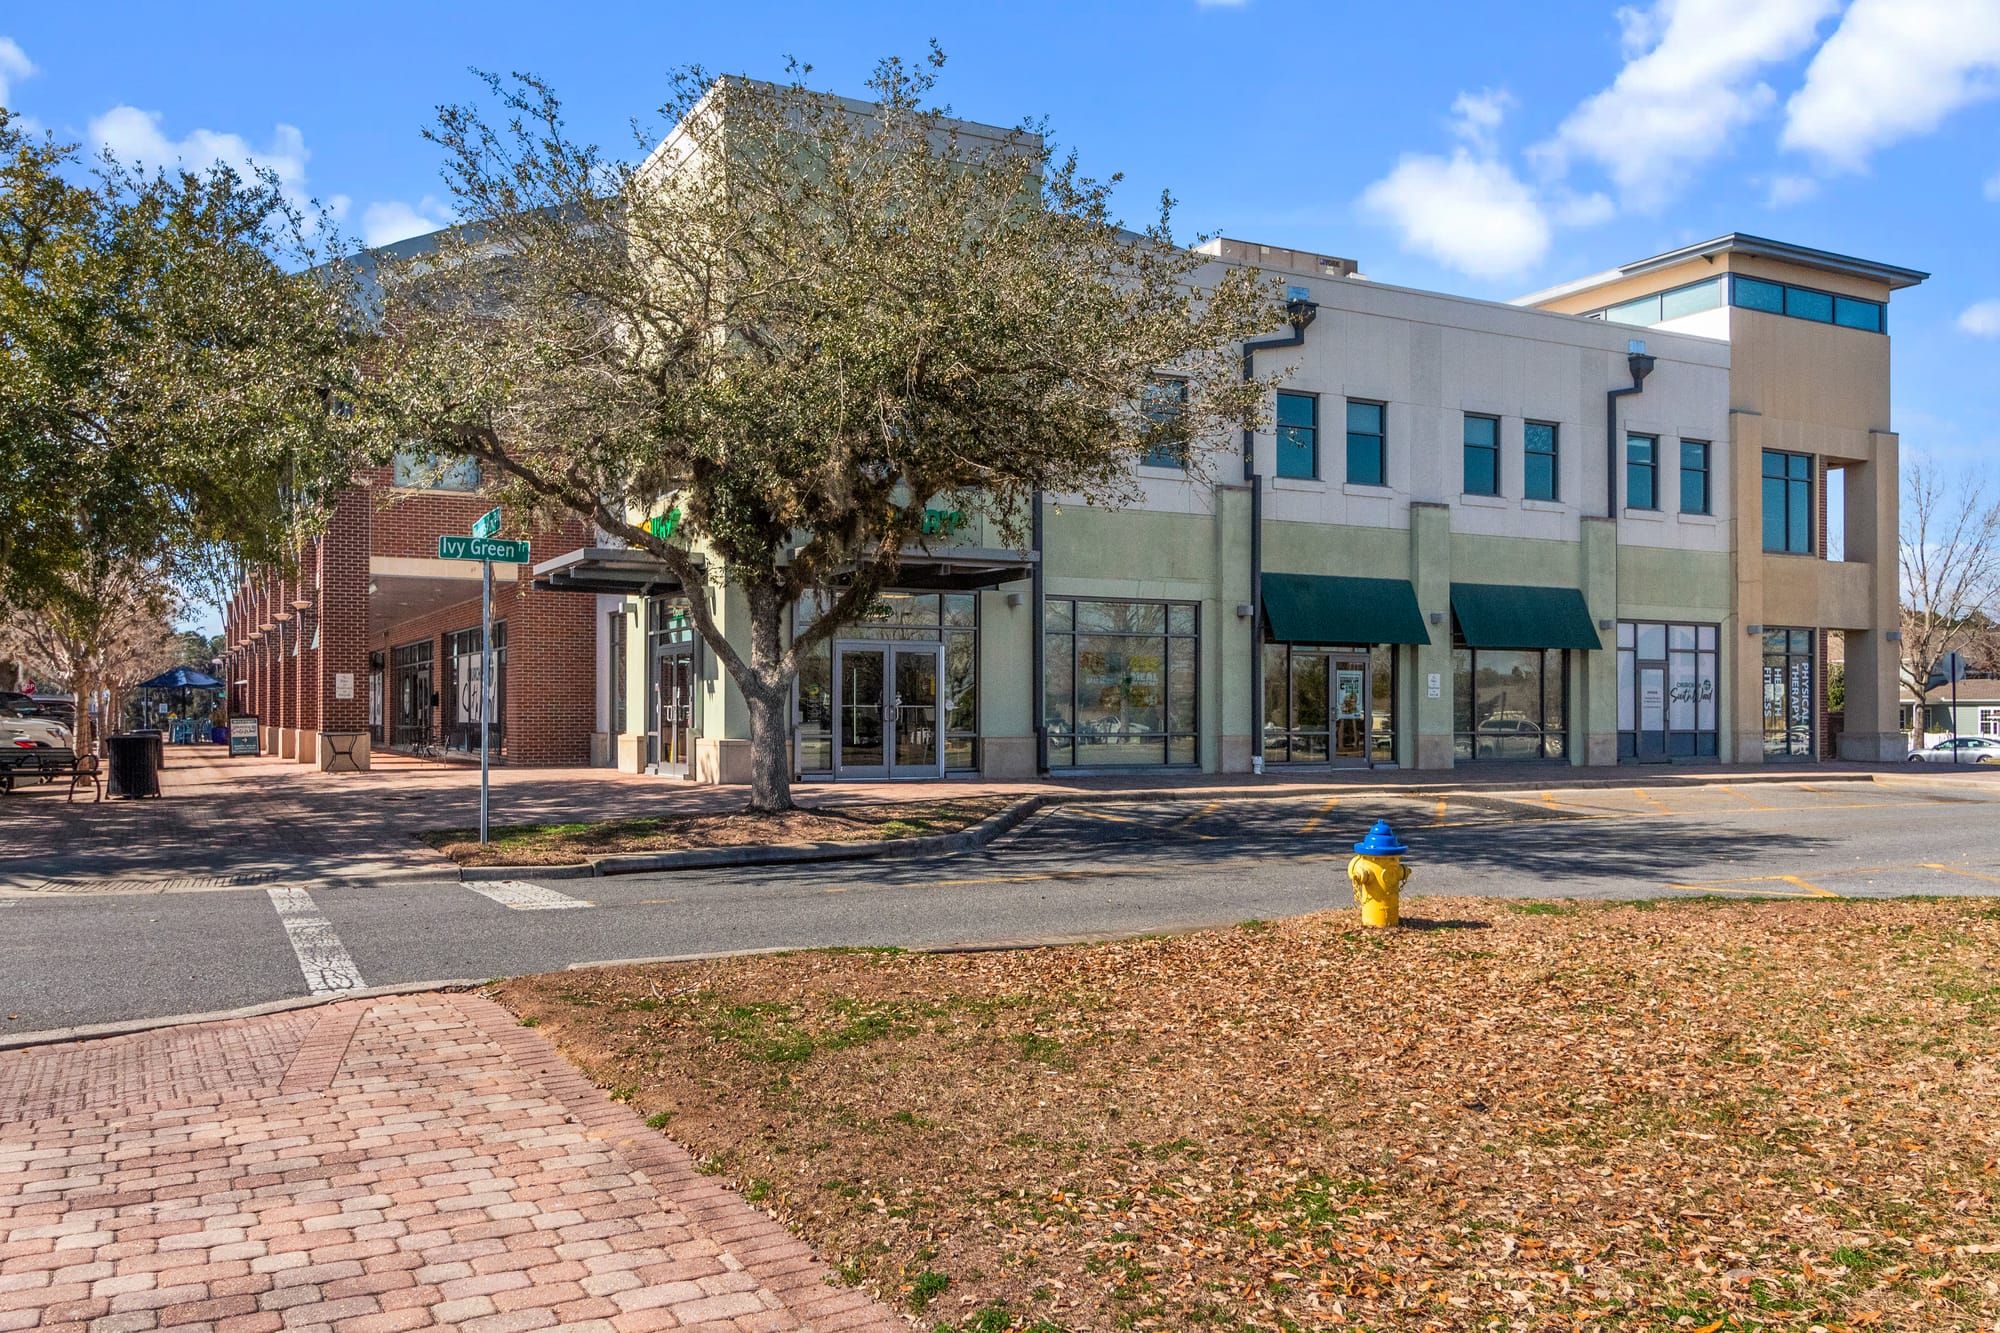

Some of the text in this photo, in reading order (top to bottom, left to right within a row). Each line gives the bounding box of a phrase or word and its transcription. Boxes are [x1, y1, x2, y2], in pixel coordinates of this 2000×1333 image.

[443, 537, 527, 558] Ivy Green Tr
[1791, 664, 1800, 721] THERAPY
[1801, 662, 1809, 724] PHYSICAL
